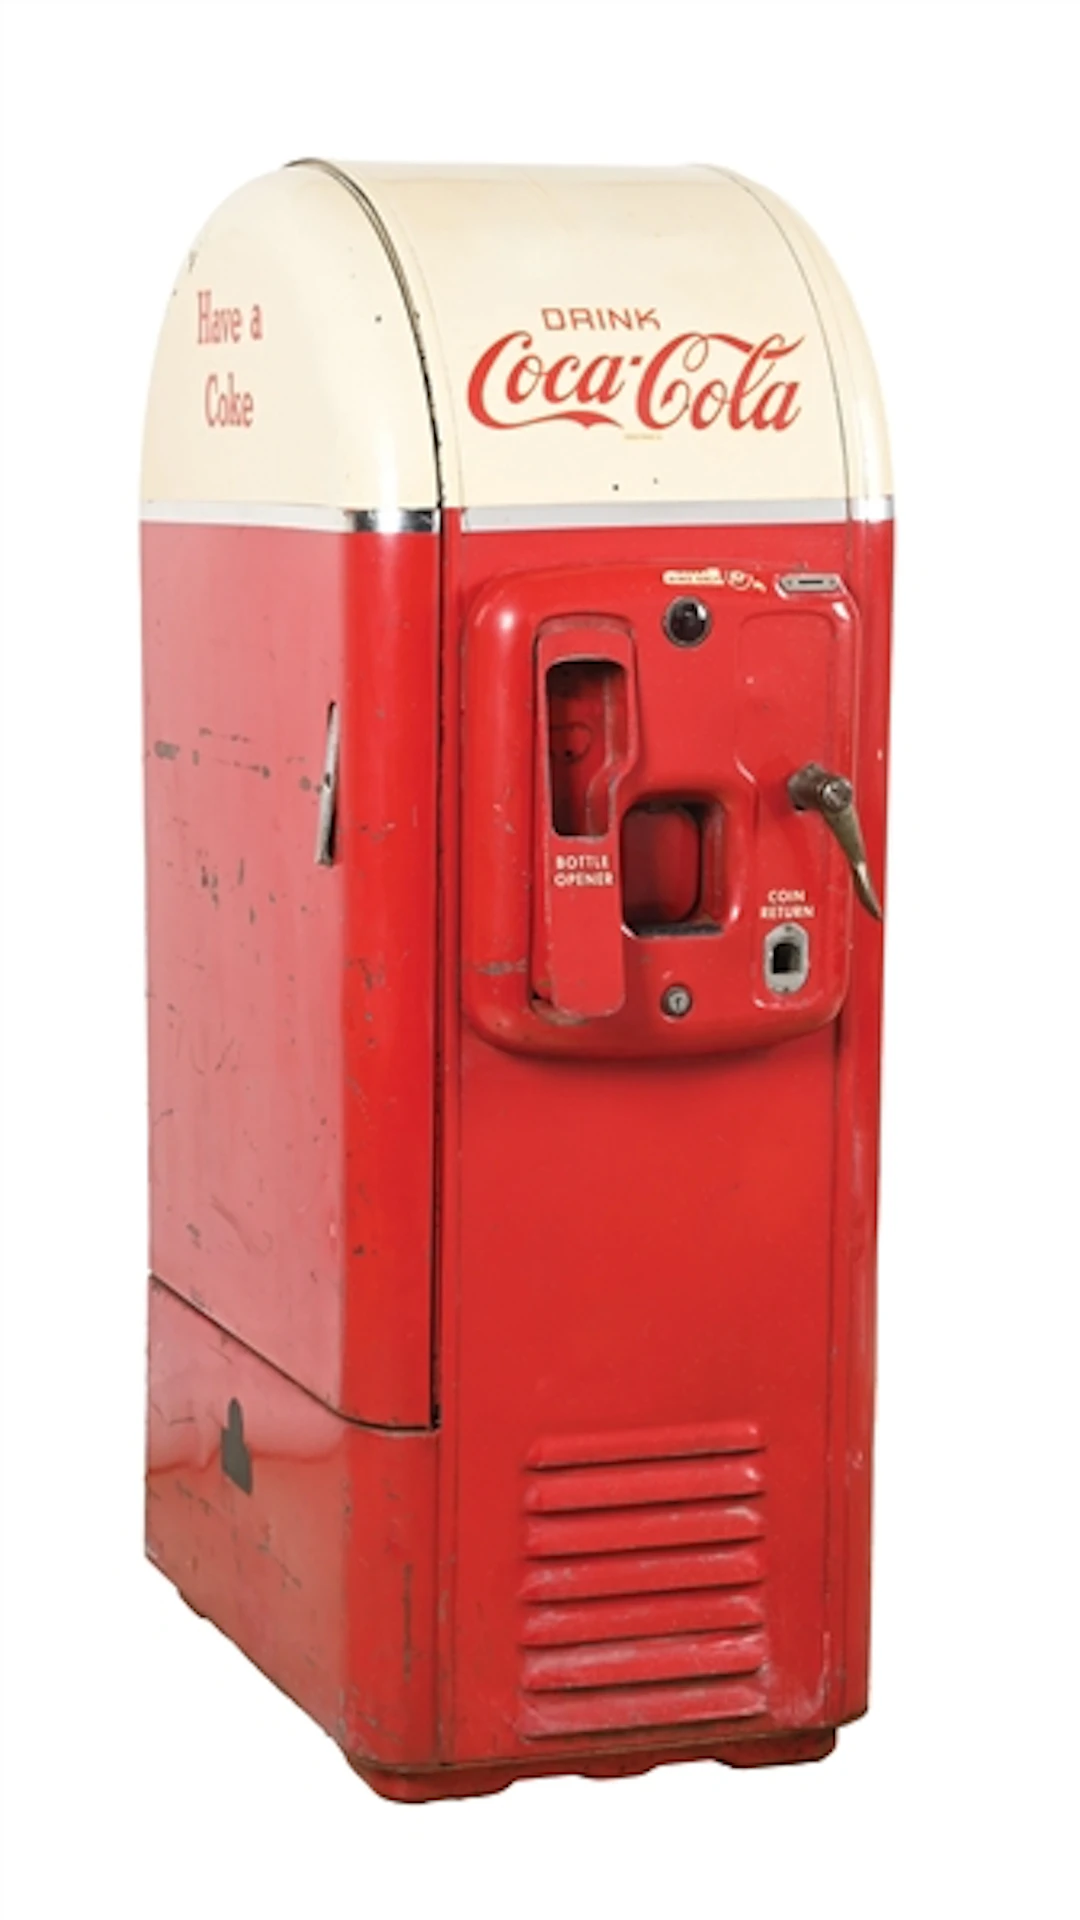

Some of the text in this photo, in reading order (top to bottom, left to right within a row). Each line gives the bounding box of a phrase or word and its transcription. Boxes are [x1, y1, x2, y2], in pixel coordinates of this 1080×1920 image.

[197, 289, 262, 344] Have a
[541, 307, 661, 331] DRINK
[467, 330, 805, 432] Coca-Cola
[204, 371, 254, 427] Coke
[556, 855, 609, 870] BOTTLE
[553, 871, 614, 888] OPENER
[767, 888, 806, 903] COIN
[760, 905, 815, 919] RETURN
